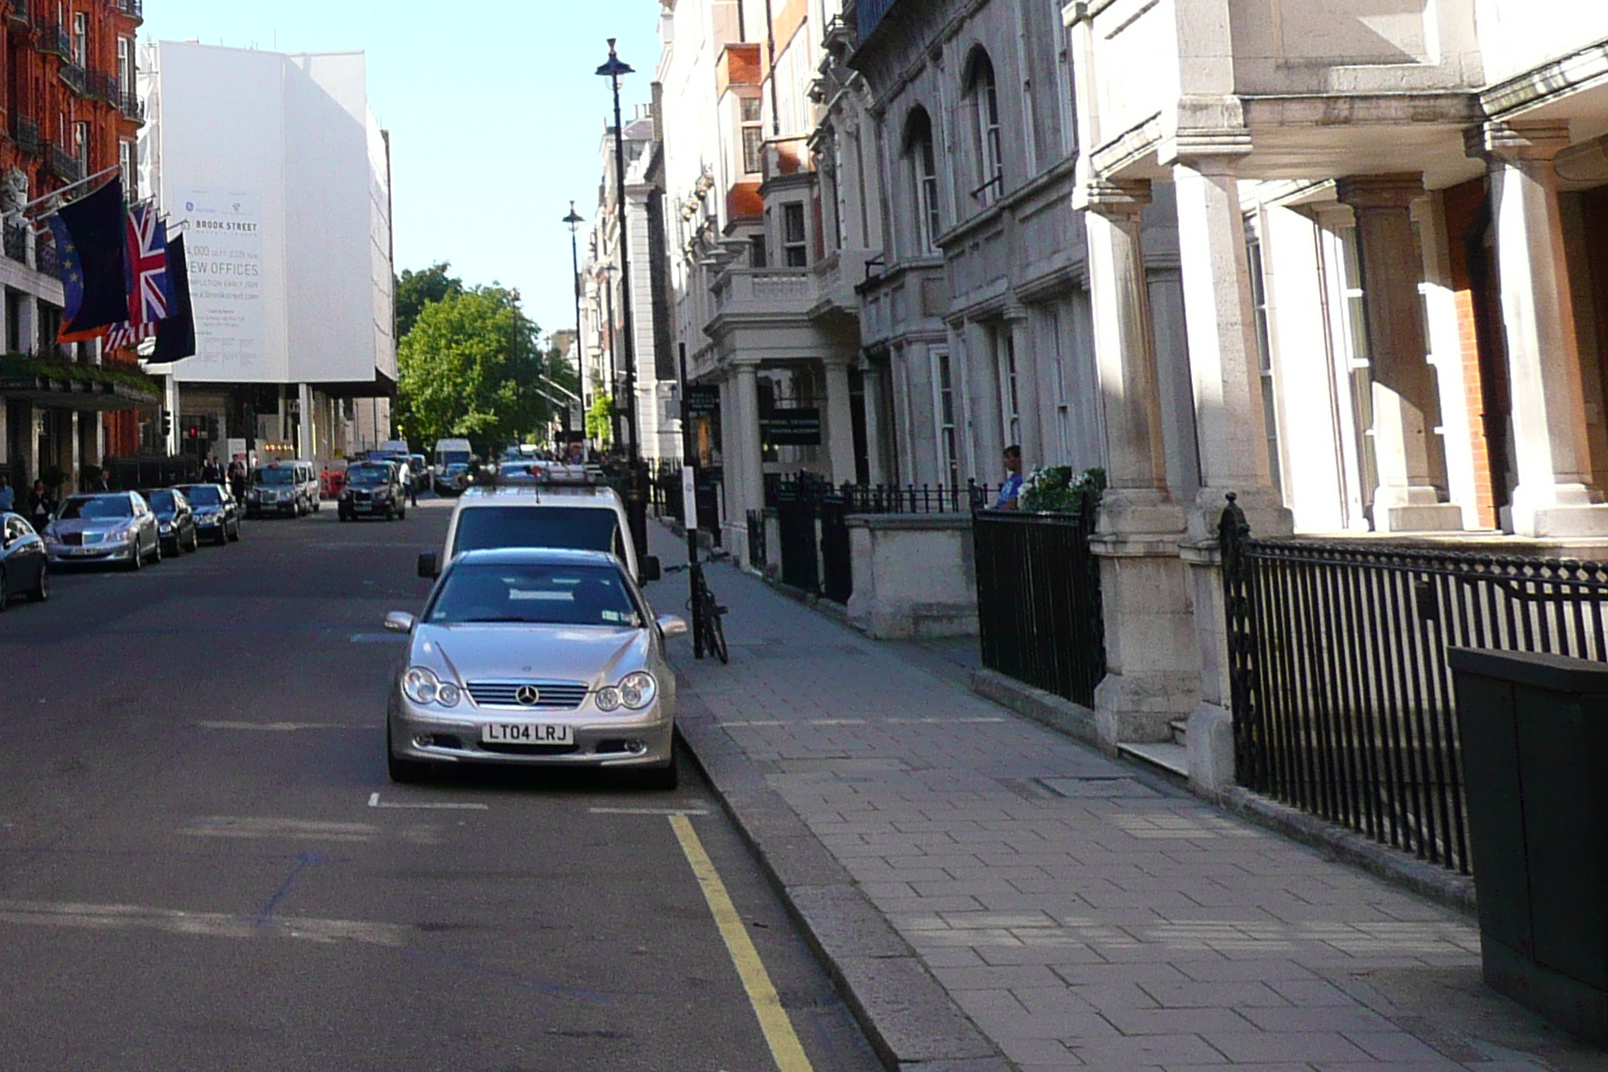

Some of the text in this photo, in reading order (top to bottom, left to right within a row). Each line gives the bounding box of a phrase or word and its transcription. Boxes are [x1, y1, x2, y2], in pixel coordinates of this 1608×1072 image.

[196, 219, 224, 230] BROOK
[226, 221, 258, 232] STREET
[189, 260, 259, 277] EW OFFICES
[489, 723, 566, 741] LT04 LRJ
